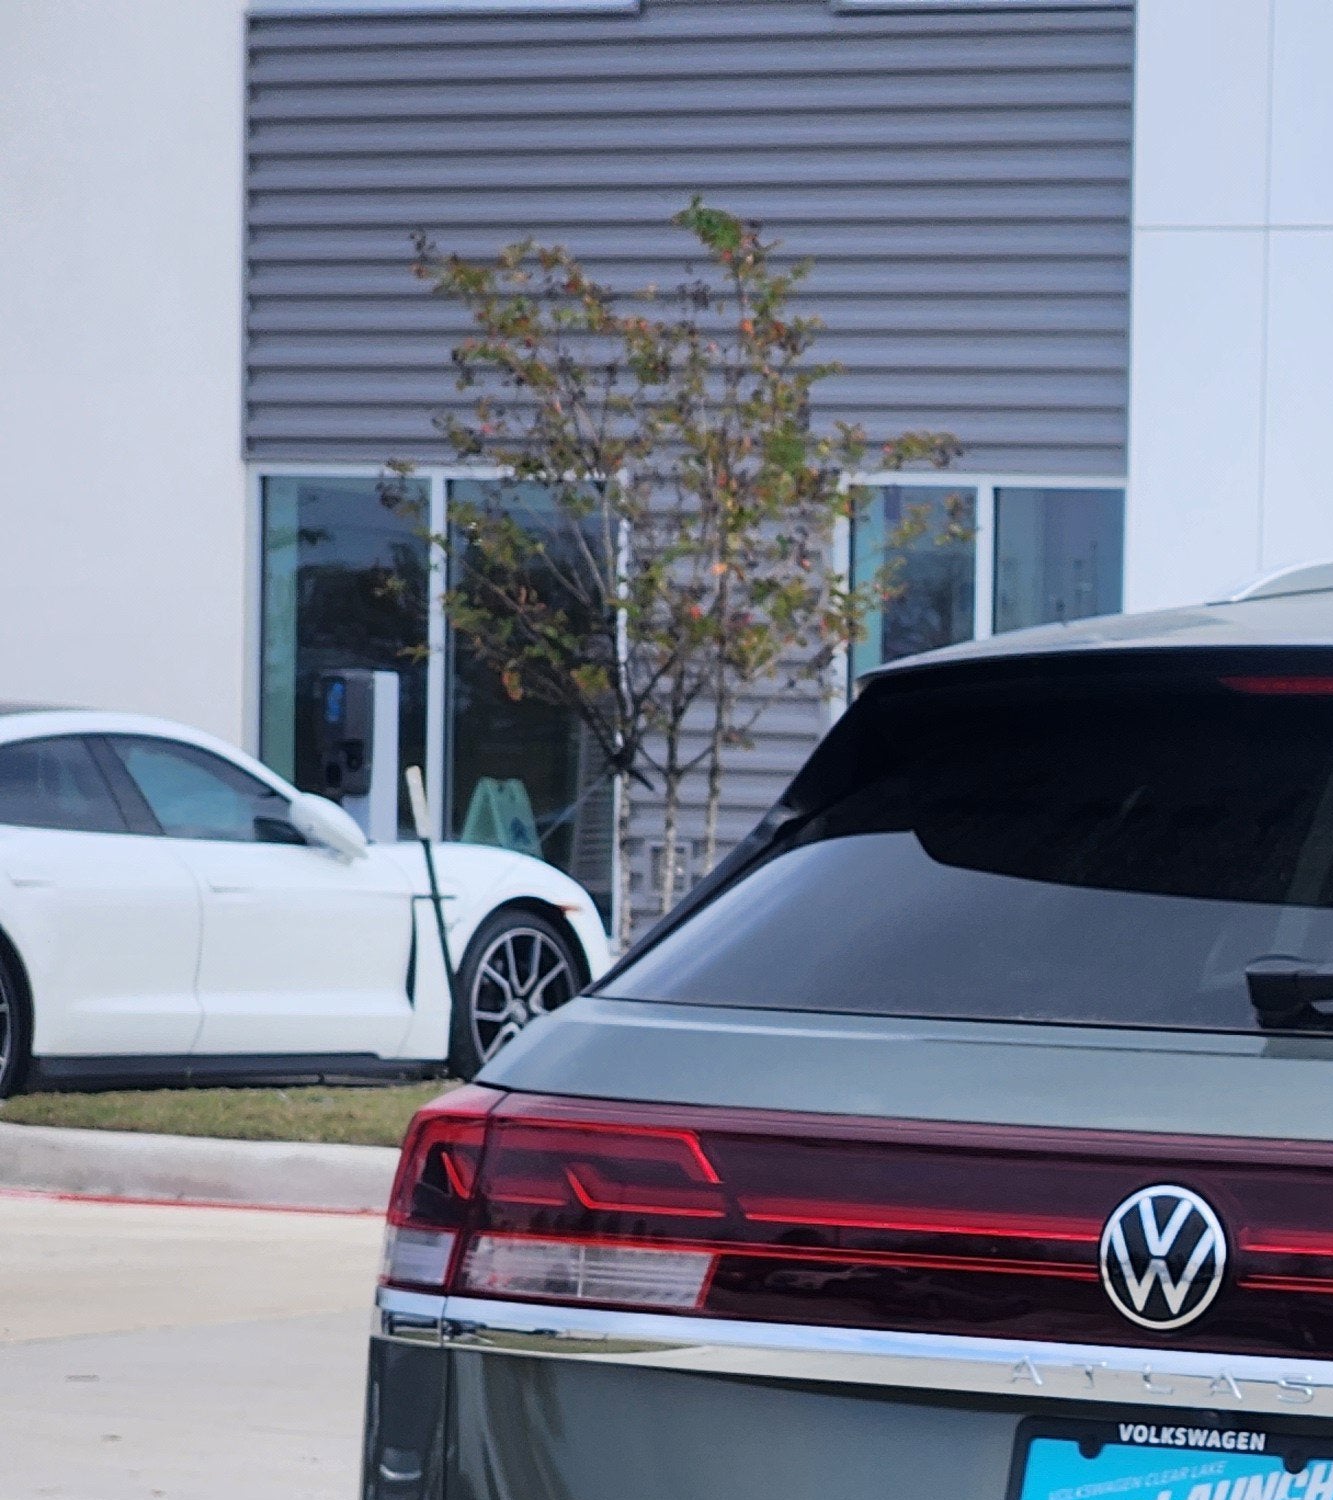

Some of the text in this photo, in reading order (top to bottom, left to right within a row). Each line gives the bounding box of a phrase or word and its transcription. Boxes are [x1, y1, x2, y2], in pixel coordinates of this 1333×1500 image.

[1100, 1184, 1227, 1330] VW
[1010, 1355, 1315, 1403] ATLAS
[1118, 1422, 1266, 1452] VOLKSWAGEN
